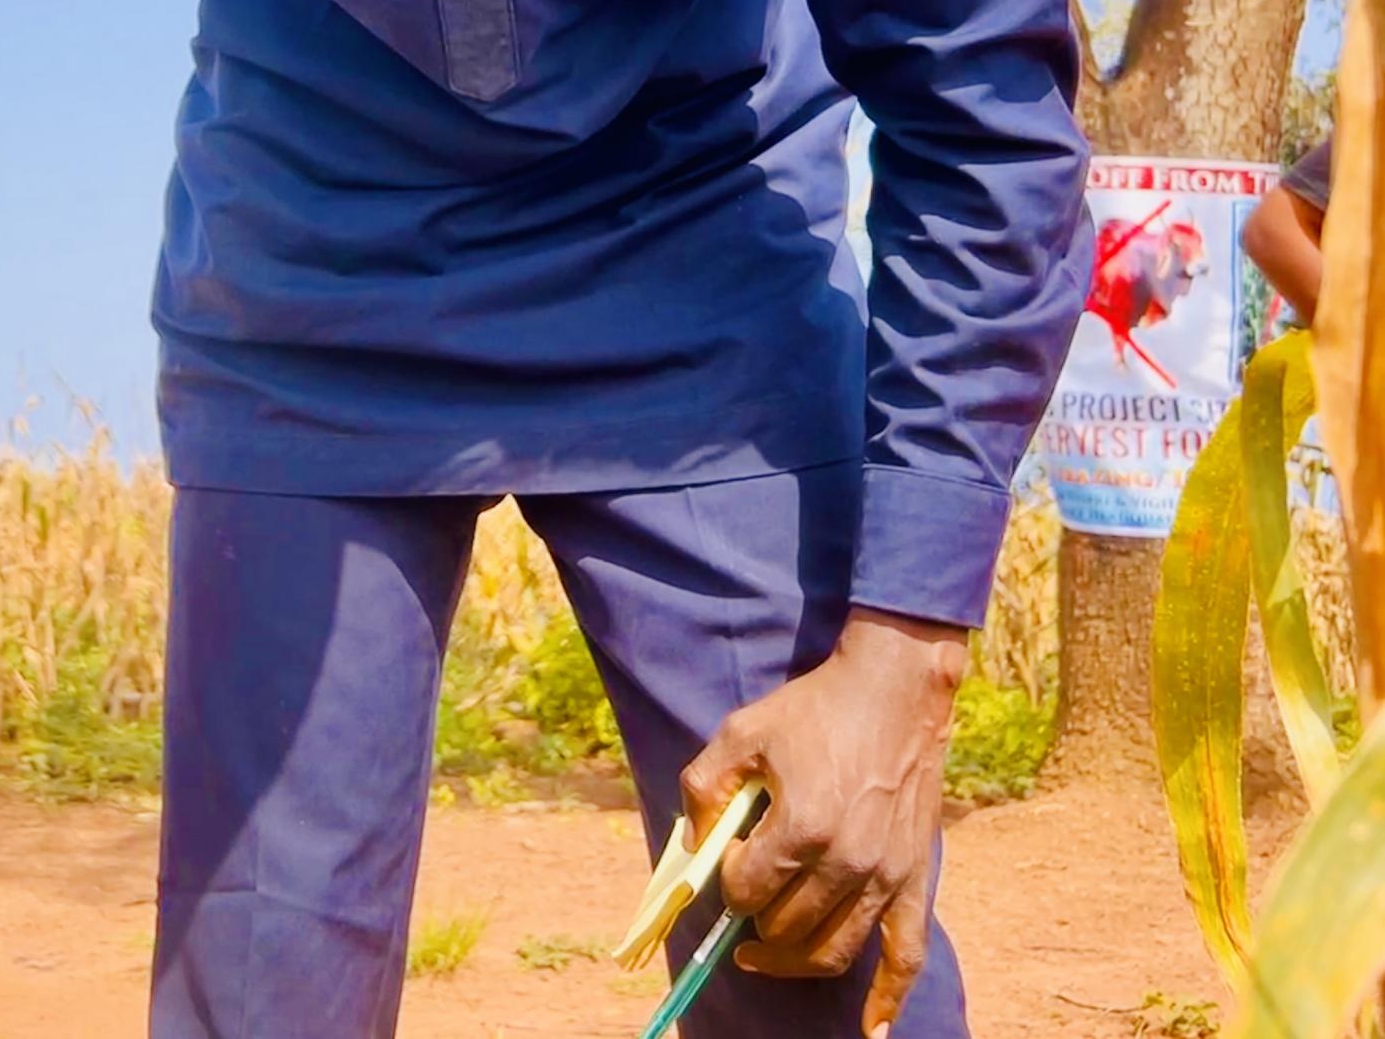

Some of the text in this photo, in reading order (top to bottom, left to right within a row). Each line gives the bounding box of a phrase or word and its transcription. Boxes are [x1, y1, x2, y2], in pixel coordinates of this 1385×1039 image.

[1152, 168, 1242, 194] FROM
[1061, 393, 1181, 422] PROJECT
[1043, 423, 1146, 459] ERVEST
